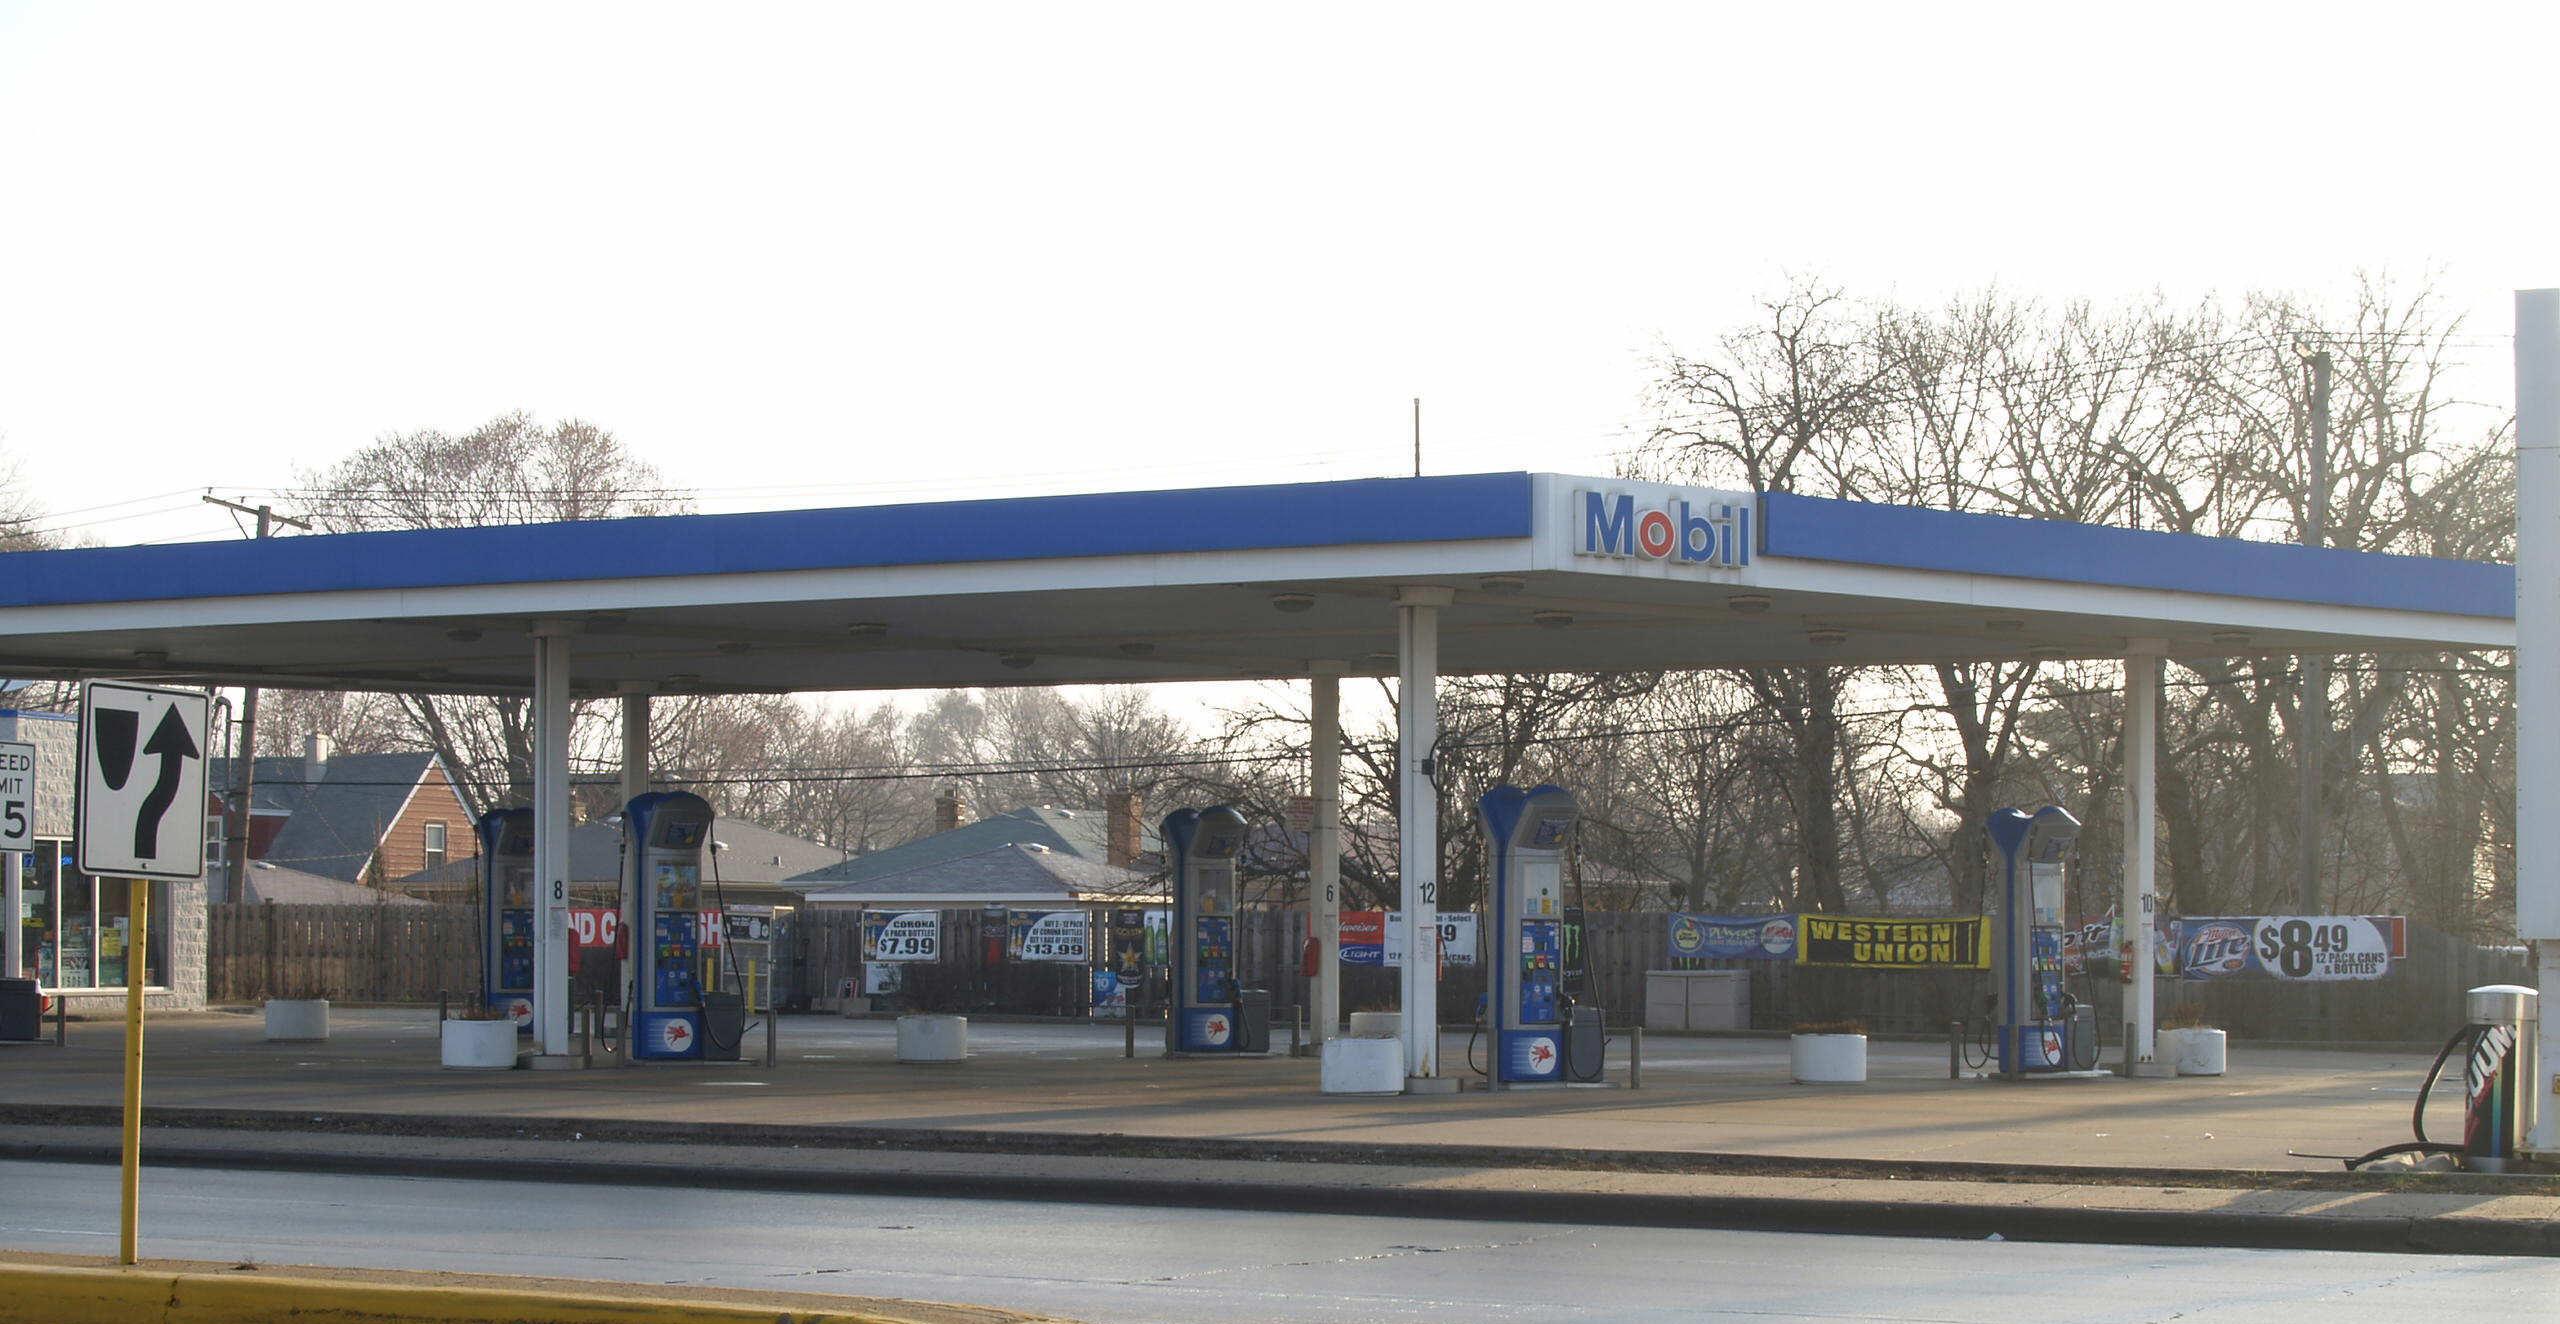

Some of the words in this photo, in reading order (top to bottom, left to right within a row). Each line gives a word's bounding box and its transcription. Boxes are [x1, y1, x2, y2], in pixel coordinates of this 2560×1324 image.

[1583, 490, 1750, 567] Mobil
[554, 880, 563, 899] 8
[1325, 885, 1333, 902] 6
[1419, 882, 1435, 904] 12
[2141, 894, 2153, 912] 10
[1810, 921, 1950, 942] WESTERN
[880, 938, 935, 955] $7.99
[1025, 944, 1083, 955] $13.99
[1853, 942, 1950, 962] UNION
[2315, 953, 2326, 964] 12
[2328, 953, 2355, 964] PACK
[2357, 953, 2385, 964] CANS
[2334, 964, 2377, 975] BOTTLES
